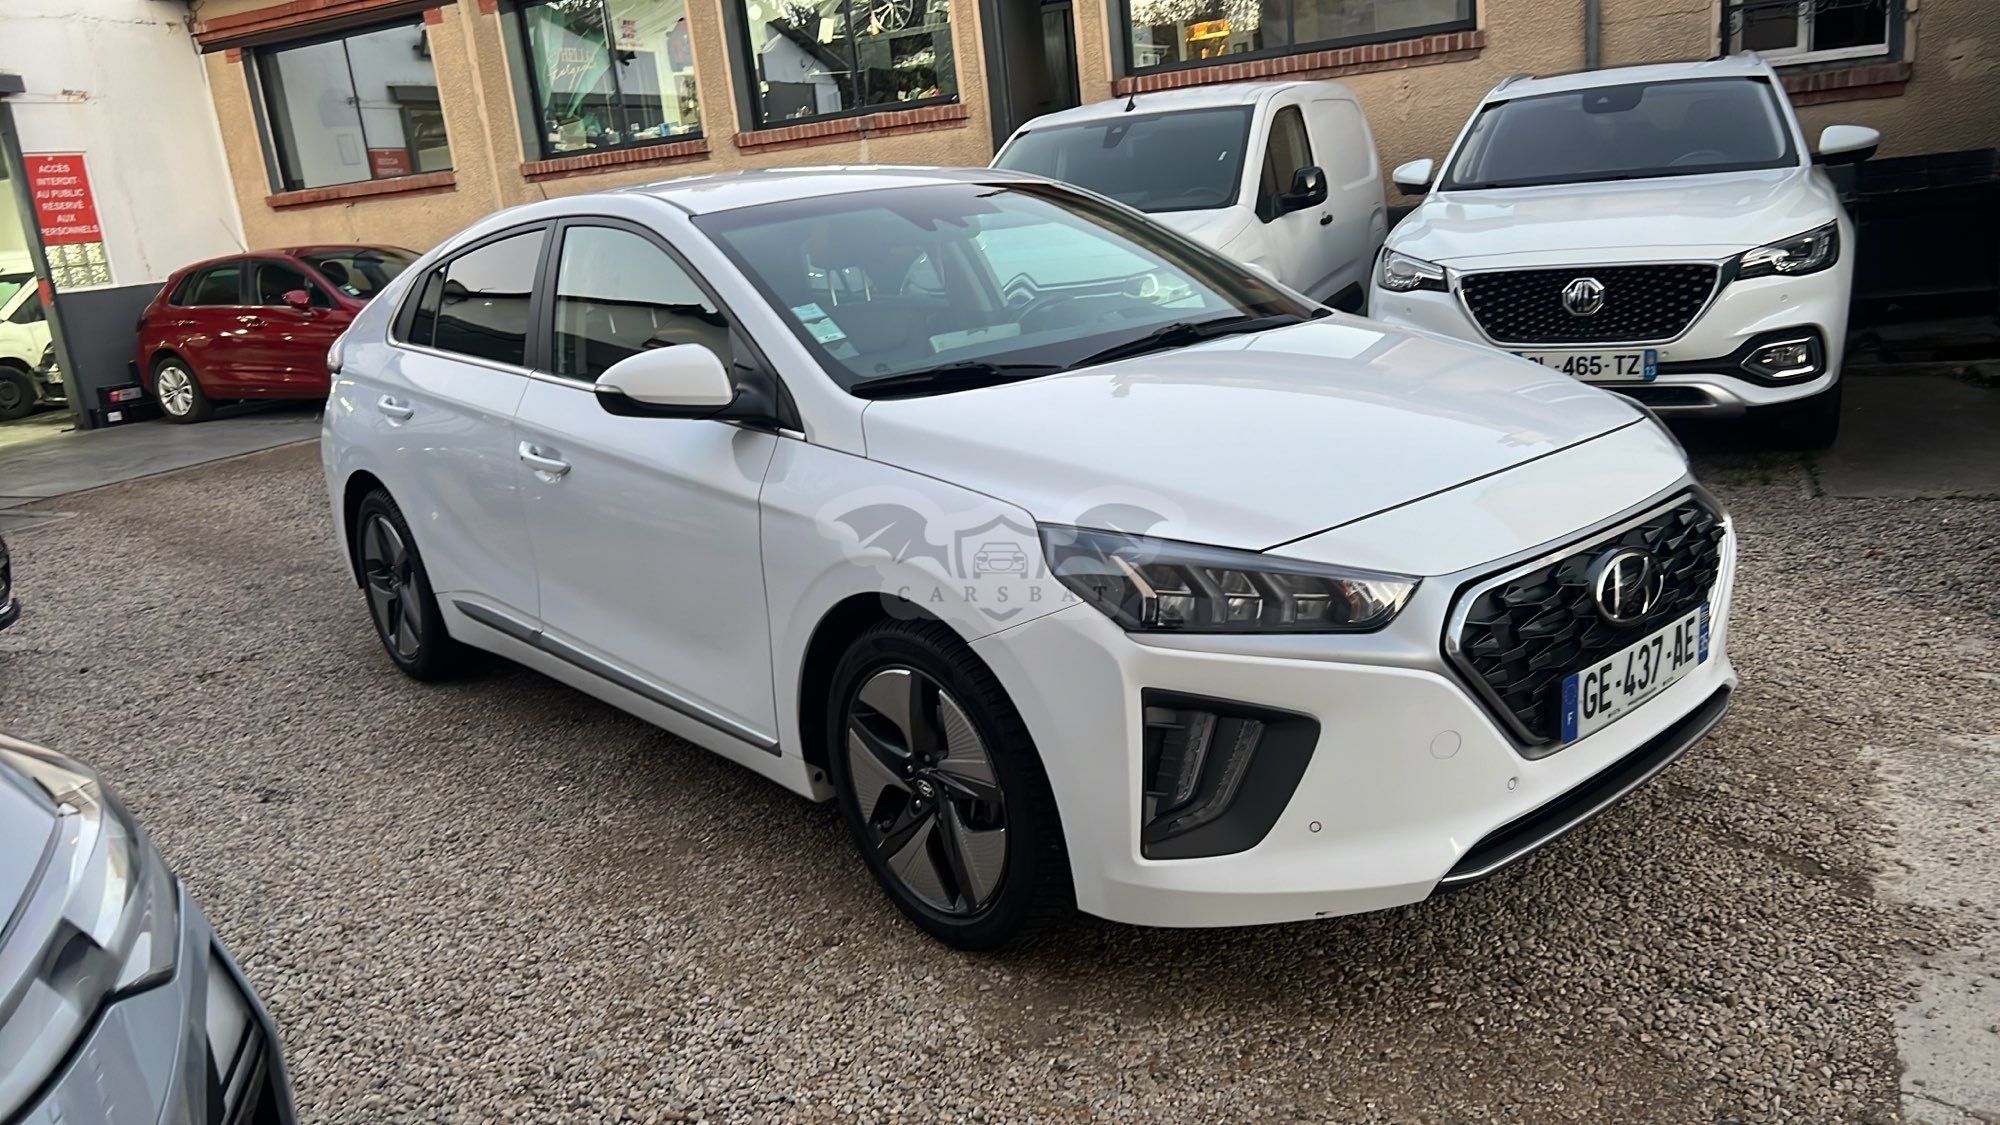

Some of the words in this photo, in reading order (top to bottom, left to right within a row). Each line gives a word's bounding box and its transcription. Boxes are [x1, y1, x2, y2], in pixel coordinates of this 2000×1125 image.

[36, 176, 77, 186] INTERDIT
[37, 190, 50, 199] AU
[51, 188, 85, 198] PUBLIC
[56, 214, 77, 223] AUX
[1567, 712, 1574, 726] F
